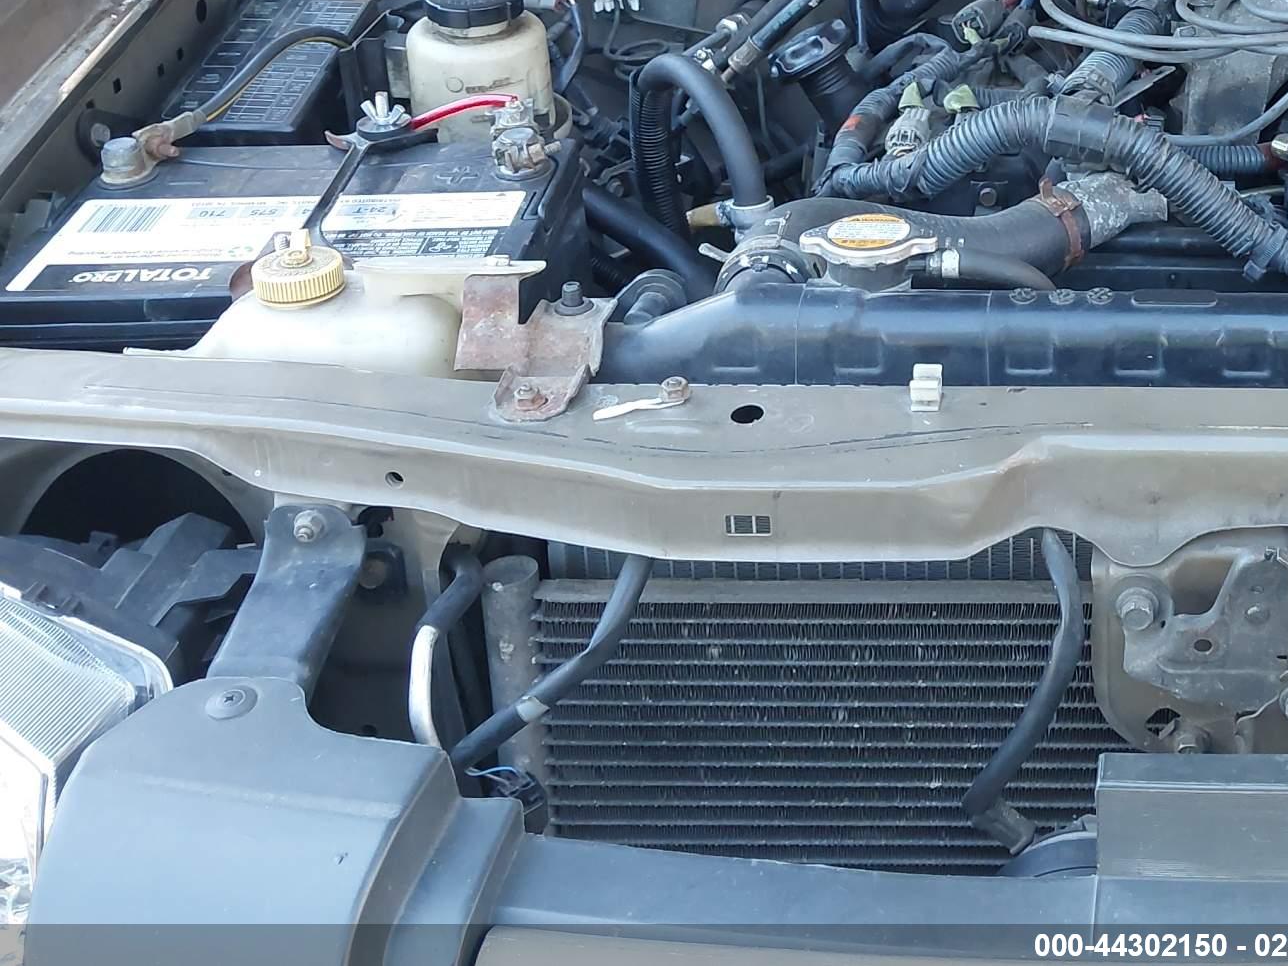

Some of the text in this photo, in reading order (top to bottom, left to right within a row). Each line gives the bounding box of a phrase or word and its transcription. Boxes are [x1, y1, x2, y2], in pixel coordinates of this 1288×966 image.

[199, 206, 226, 217] 710
[250, 208, 277, 217] 575
[352, 206, 388, 215] 24-T
[72, 267, 213, 283] TOTALPRO
